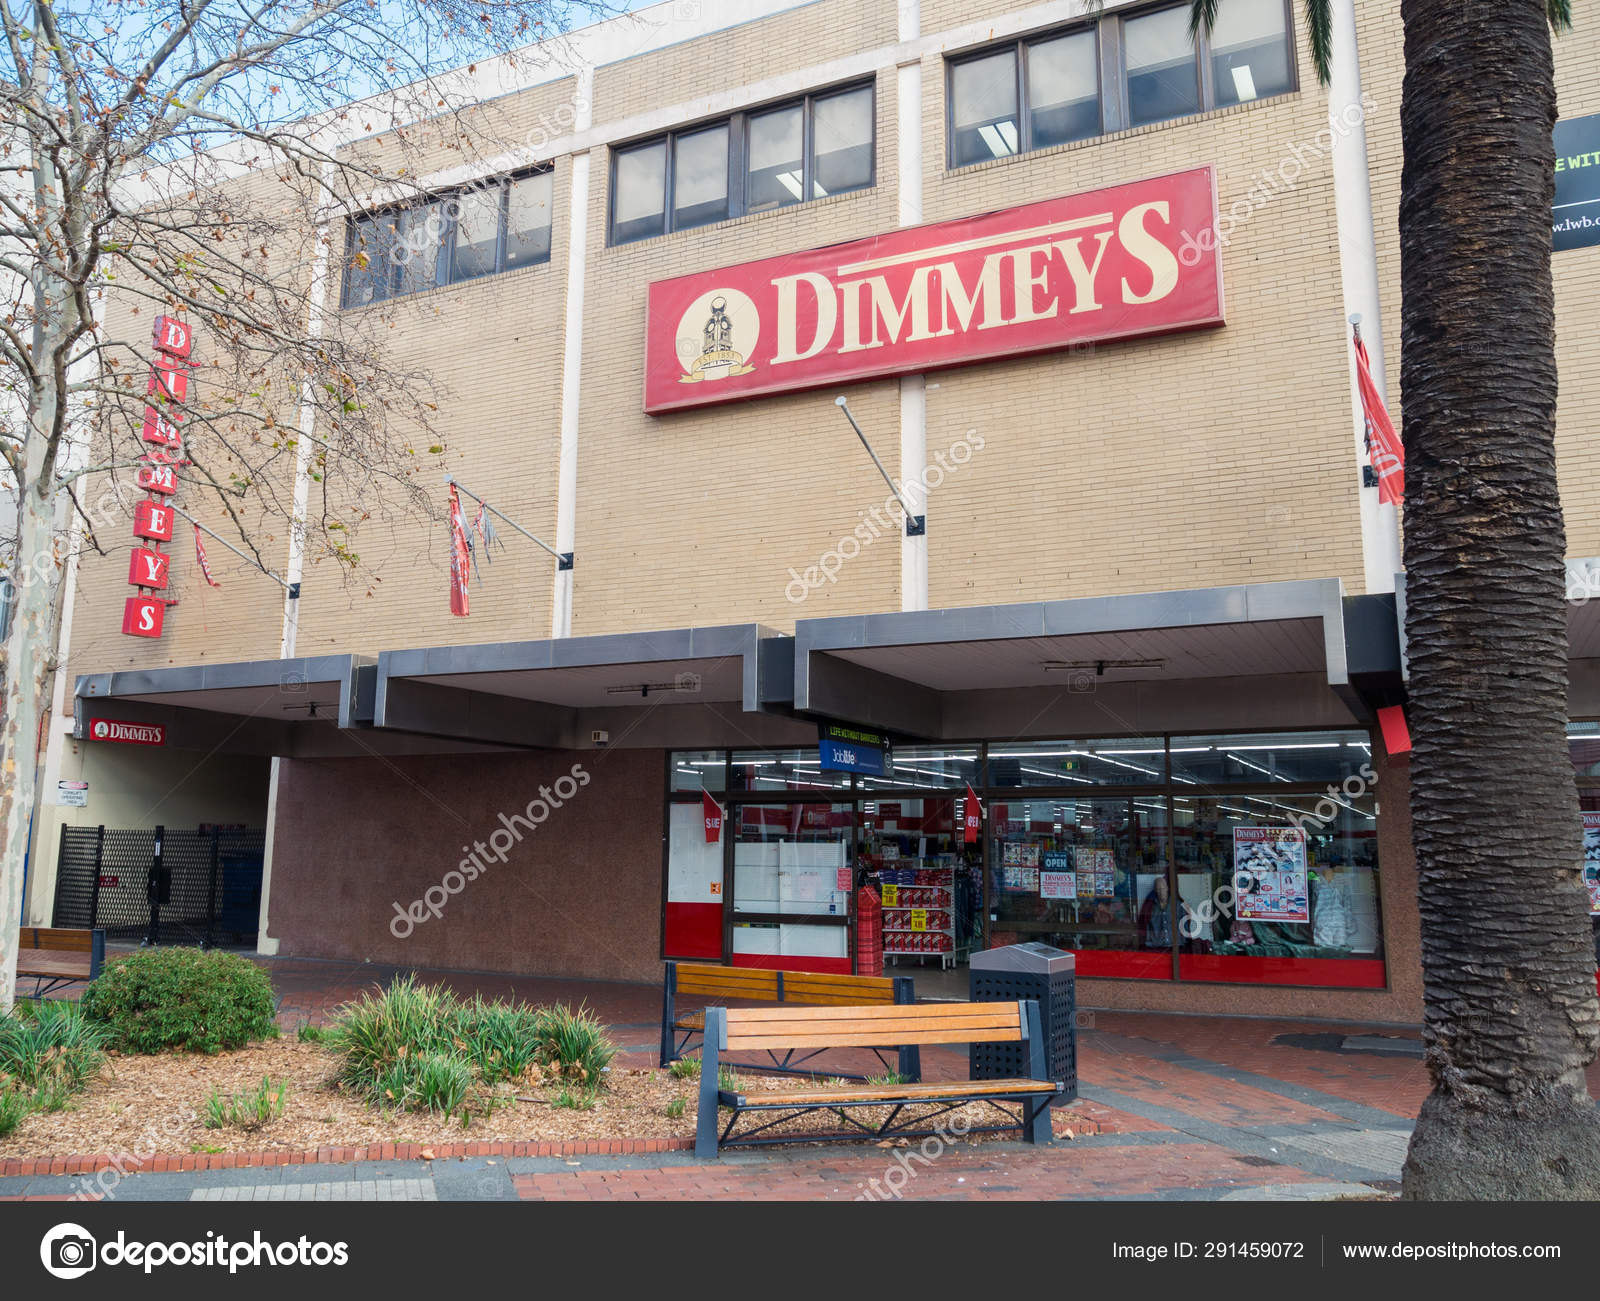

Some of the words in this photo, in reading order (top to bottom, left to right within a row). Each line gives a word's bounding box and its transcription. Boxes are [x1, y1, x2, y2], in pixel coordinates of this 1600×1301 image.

[770, 200, 1179, 366] DIMMEYS
[110, 722, 162, 743] DIMMEYS
[1045, 859, 1067, 868] OPEN
